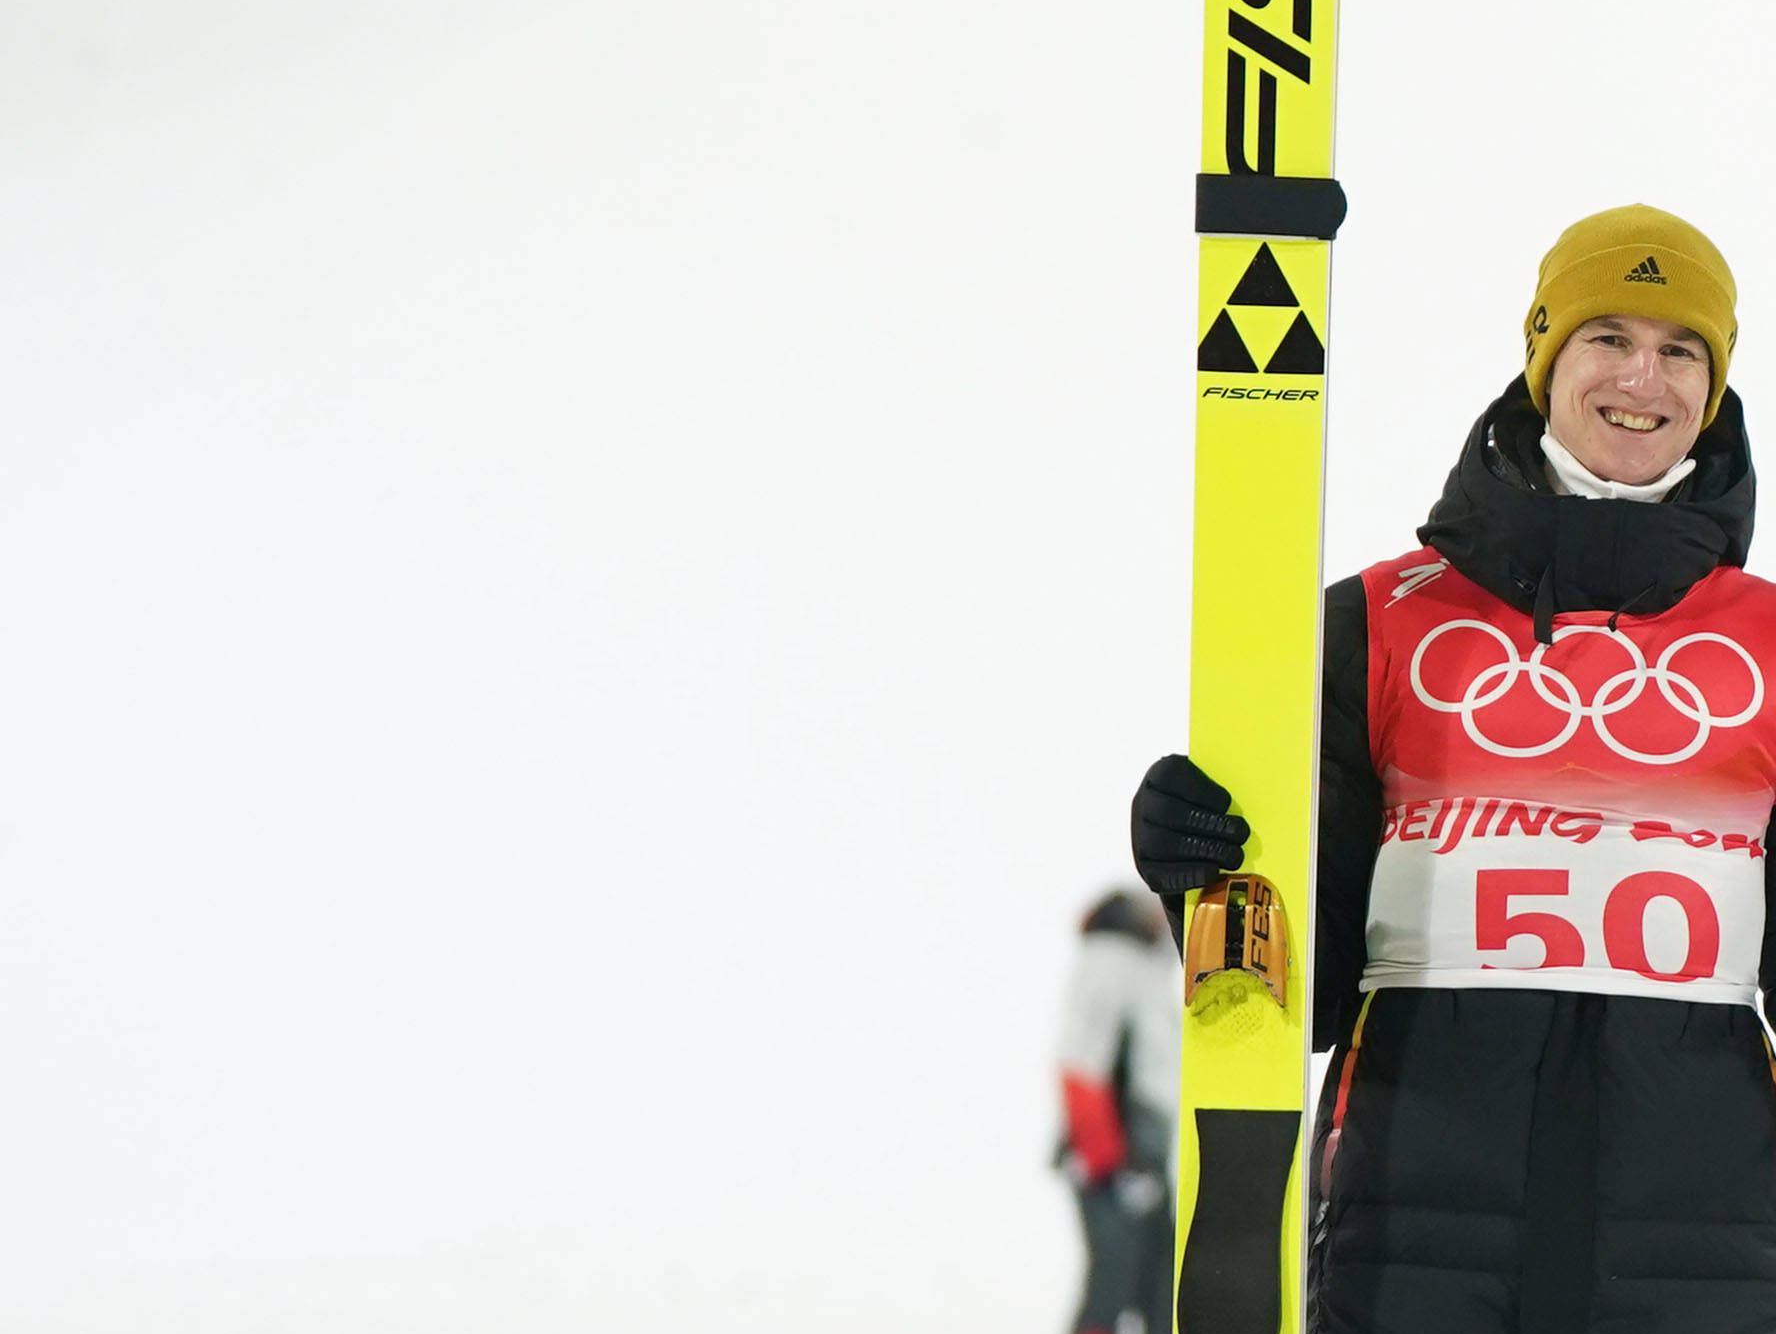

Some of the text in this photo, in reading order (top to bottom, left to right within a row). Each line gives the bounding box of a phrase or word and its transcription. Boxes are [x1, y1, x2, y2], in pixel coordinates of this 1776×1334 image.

[1623, 274, 1667, 285] adidas
[1201, 386, 1320, 402] FISCHER
[1475, 868, 1721, 984] 50
